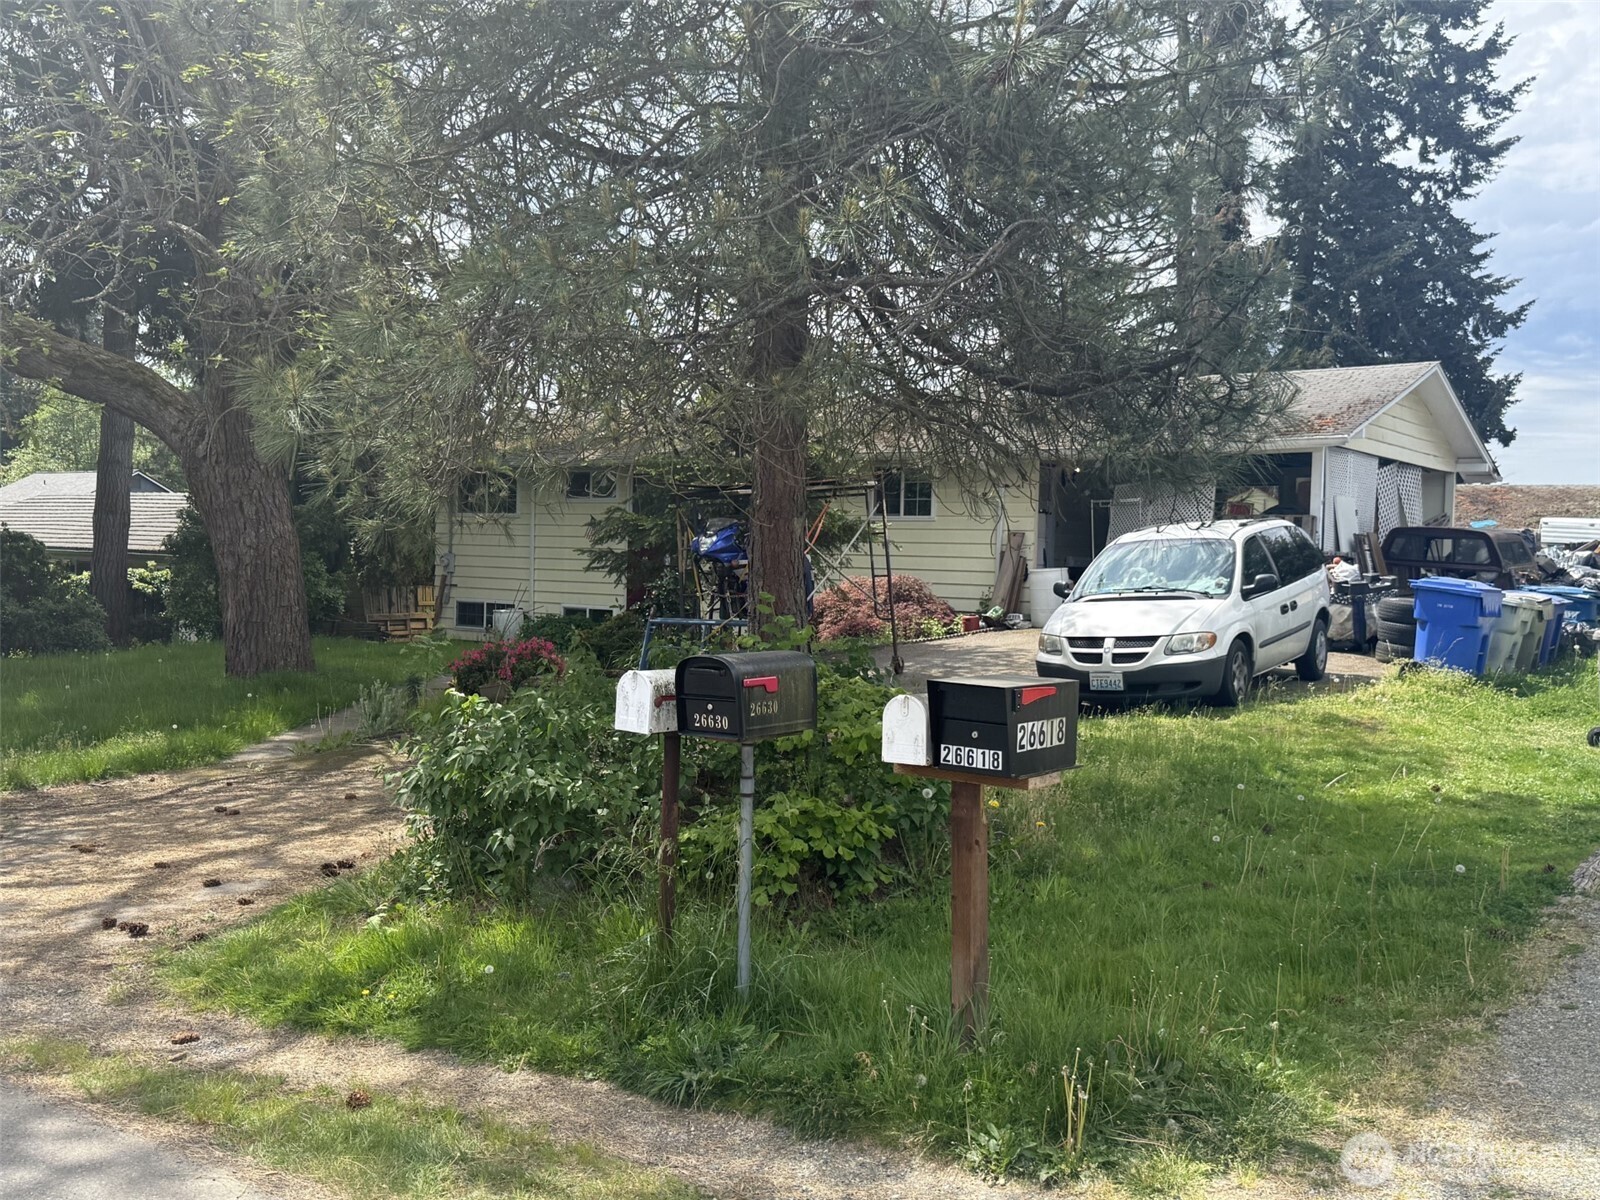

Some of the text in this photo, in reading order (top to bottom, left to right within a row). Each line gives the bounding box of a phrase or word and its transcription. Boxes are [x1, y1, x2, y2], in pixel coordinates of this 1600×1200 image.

[750, 700, 778, 717] 26630
[693, 713, 729, 730] 26630
[1018, 718, 1064, 751] 26618
[942, 745, 1001, 769] 26618
